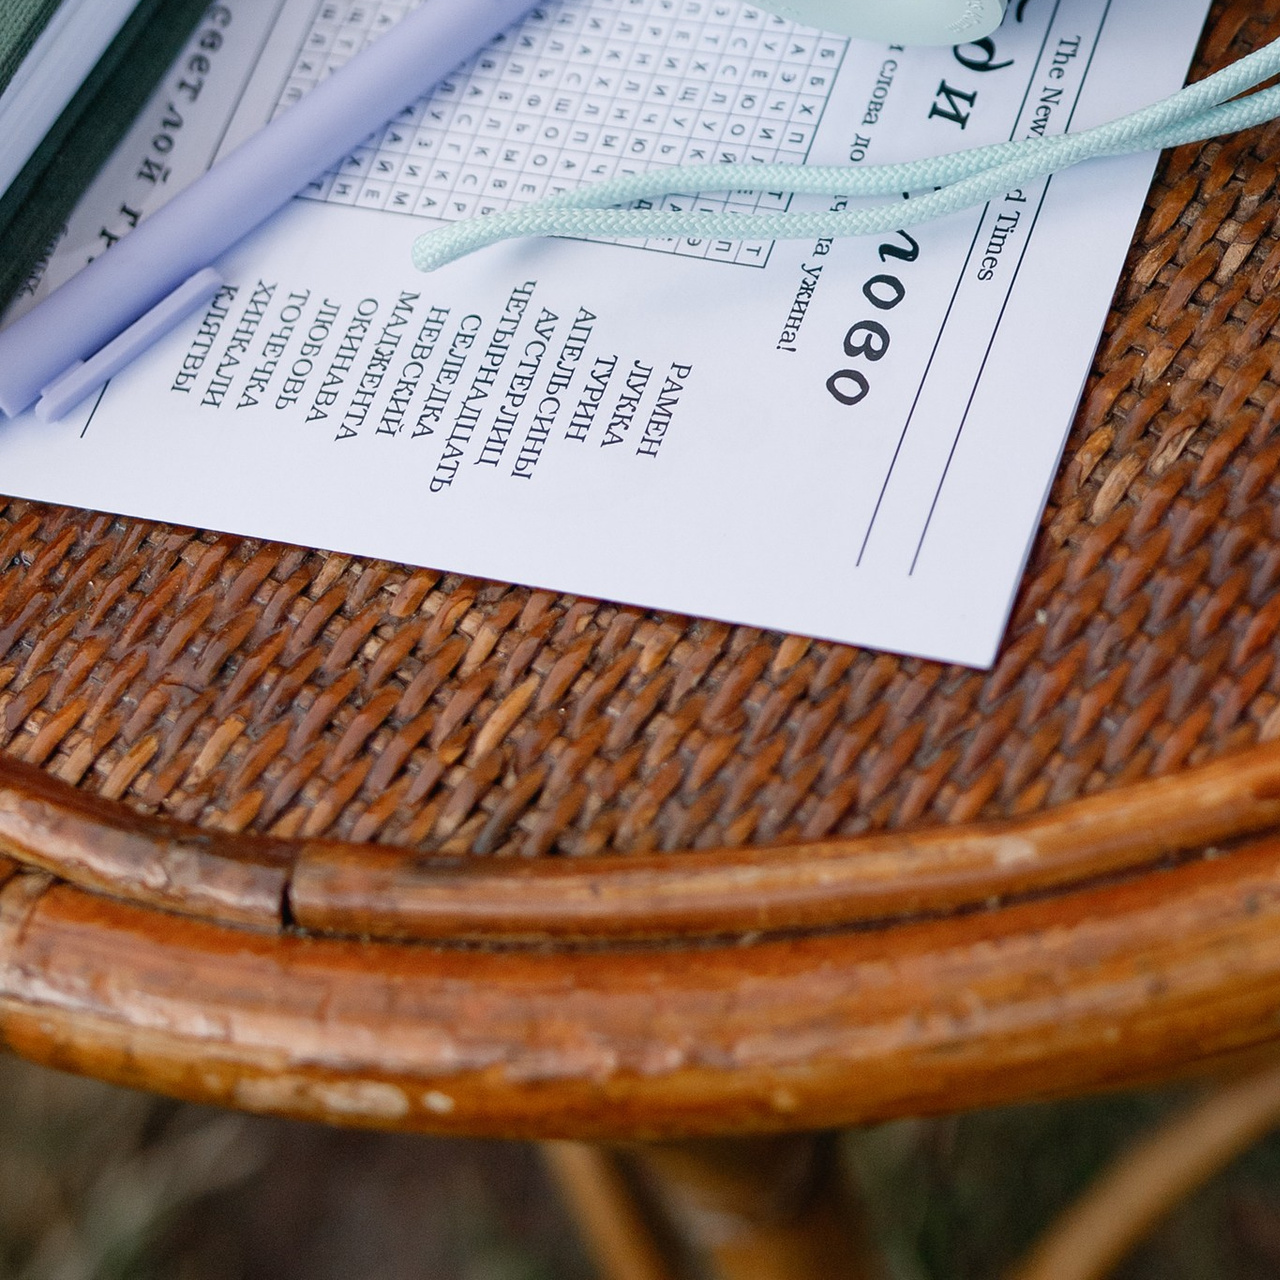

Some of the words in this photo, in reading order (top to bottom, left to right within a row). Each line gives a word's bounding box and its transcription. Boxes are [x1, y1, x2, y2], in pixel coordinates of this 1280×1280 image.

[136, 3, 233, 185] светлой
[861, 59, 898, 125] слова
[1049, 35, 1082, 80] The
[849, 133, 871, 162] до
[825, 186, 942, 406] лово
[977, 210, 1021, 281] Times
[171, 284, 239, 393] КЛЯТВЫ
[200, 279, 277, 409] ХИНКАЛИ
[235, 289, 311, 410] ТОЧЕЧКА
[274, 298, 340, 410] ЛЮБОВЬ
[304, 298, 379, 423] ОКИНАВА
[334, 291, 420, 442] МАДЖЕНТА
[776, 263, 824, 353] ужина!
[375, 306, 451, 437] НЕВСКИЙ
[410, 314, 483, 439] СЕЛЕДКА
[429, 281, 537, 493] ЧЕТЫРНАДЦАТЬ
[473, 307, 559, 467] АУСТЕРЛИЦ
[510, 306, 597, 480] АПЕЛЬСИНЫ
[564, 354, 619, 443] ТУРИН
[600, 359, 654, 448] ЛУККА
[635, 362, 693, 458] РАМЕН
